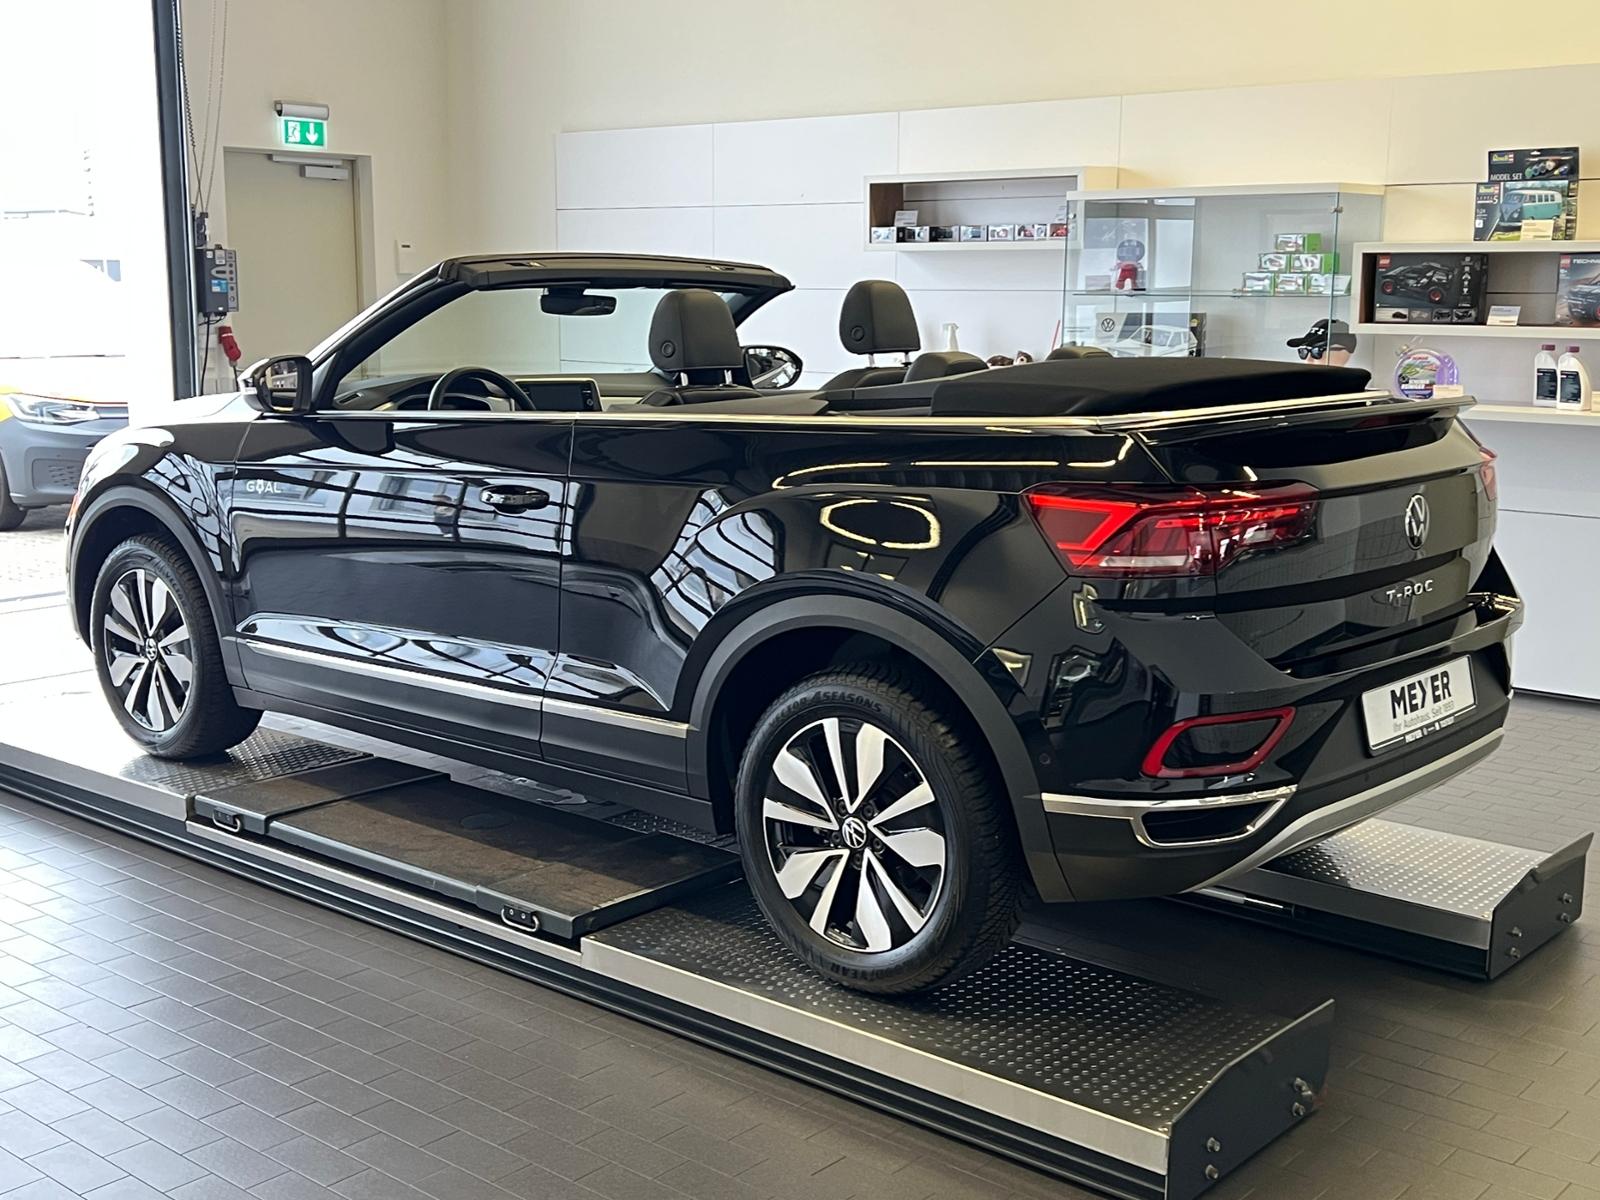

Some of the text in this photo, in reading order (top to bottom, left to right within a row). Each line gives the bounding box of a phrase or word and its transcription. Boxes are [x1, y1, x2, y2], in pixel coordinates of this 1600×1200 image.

[1512, 172, 1522, 180] SET
[246, 479, 282, 494] GOAL
[1386, 580, 1433, 602] T-ROC
[1390, 670, 1452, 719] MEYER
